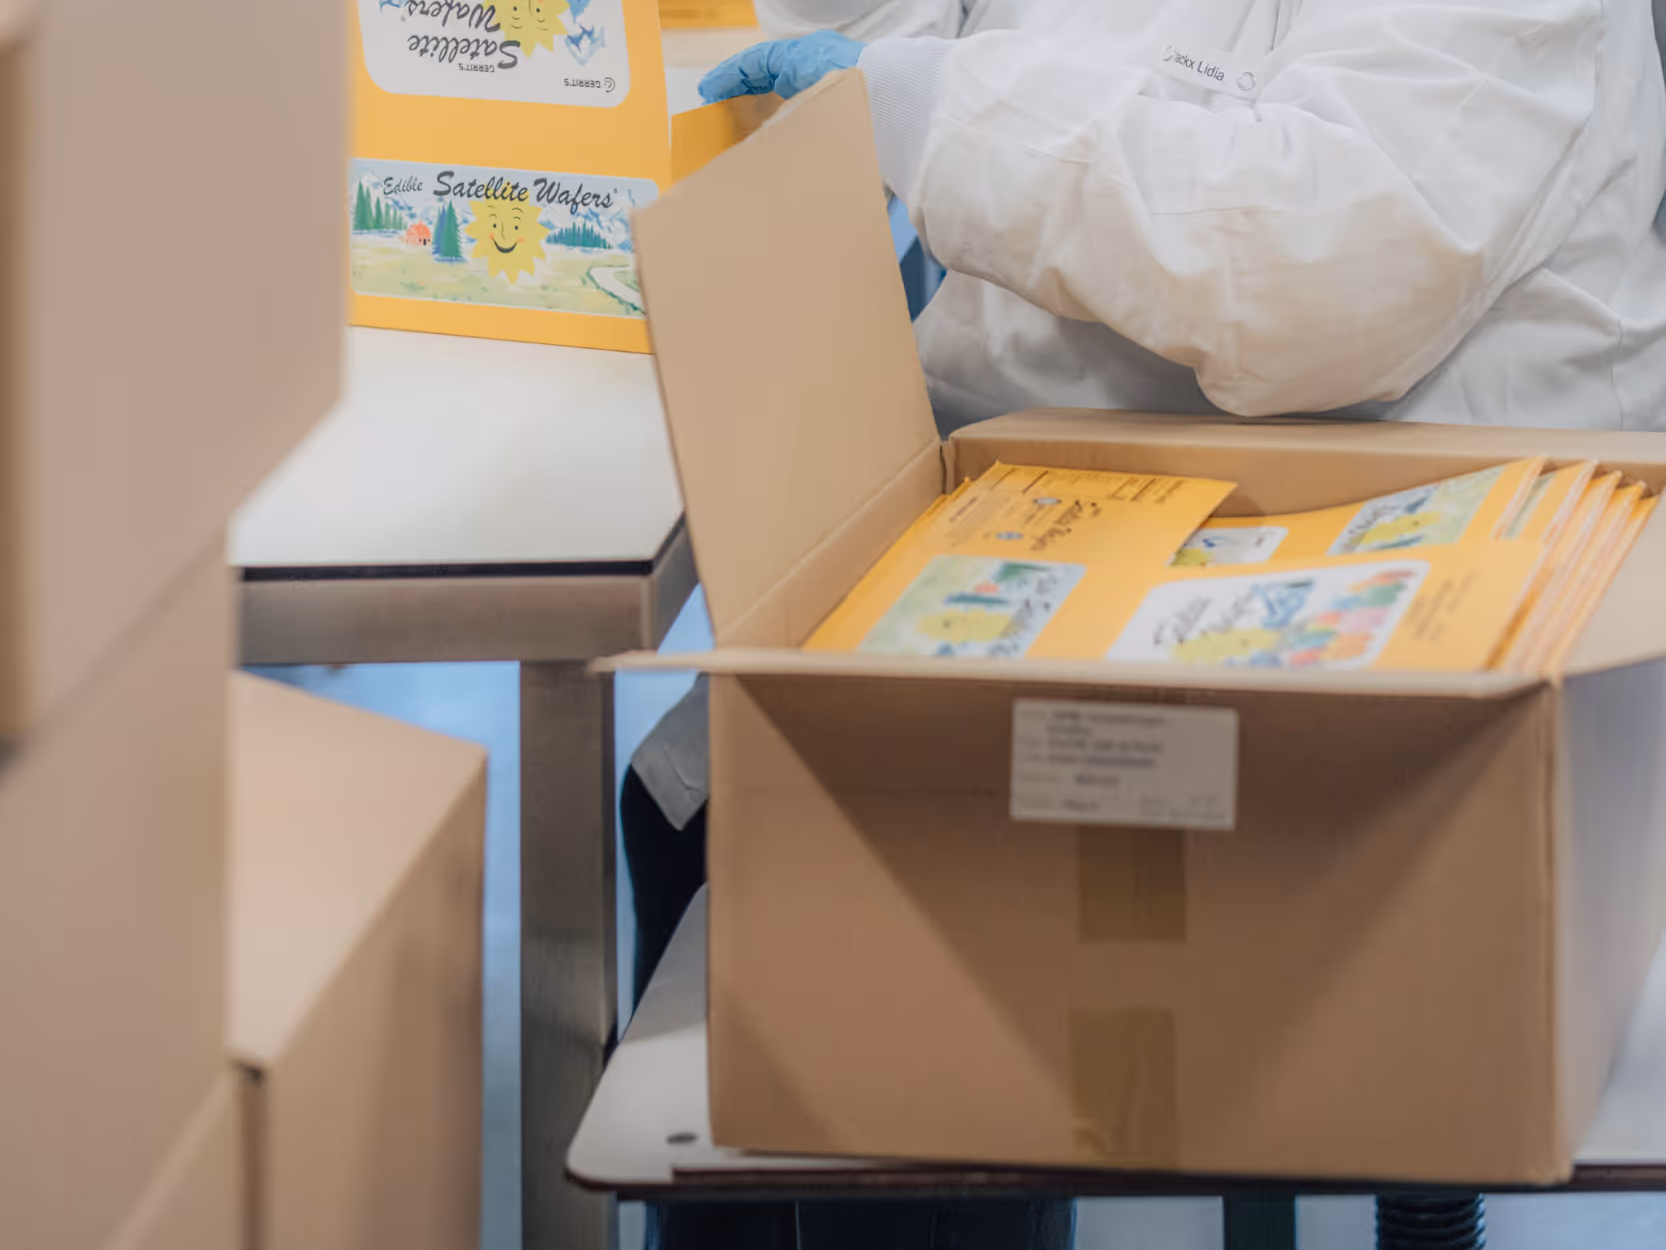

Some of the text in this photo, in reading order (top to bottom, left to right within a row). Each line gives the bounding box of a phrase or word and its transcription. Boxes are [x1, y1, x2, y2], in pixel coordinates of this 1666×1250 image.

[407, 34, 521, 69] Satellite
[458, 62, 495, 73] GERRIT'S
[1197, 60, 1225, 82] Lidia
[564, 77, 601, 89] GERRIT'S
[382, 171, 615, 215] Edible Satellite Wafers
